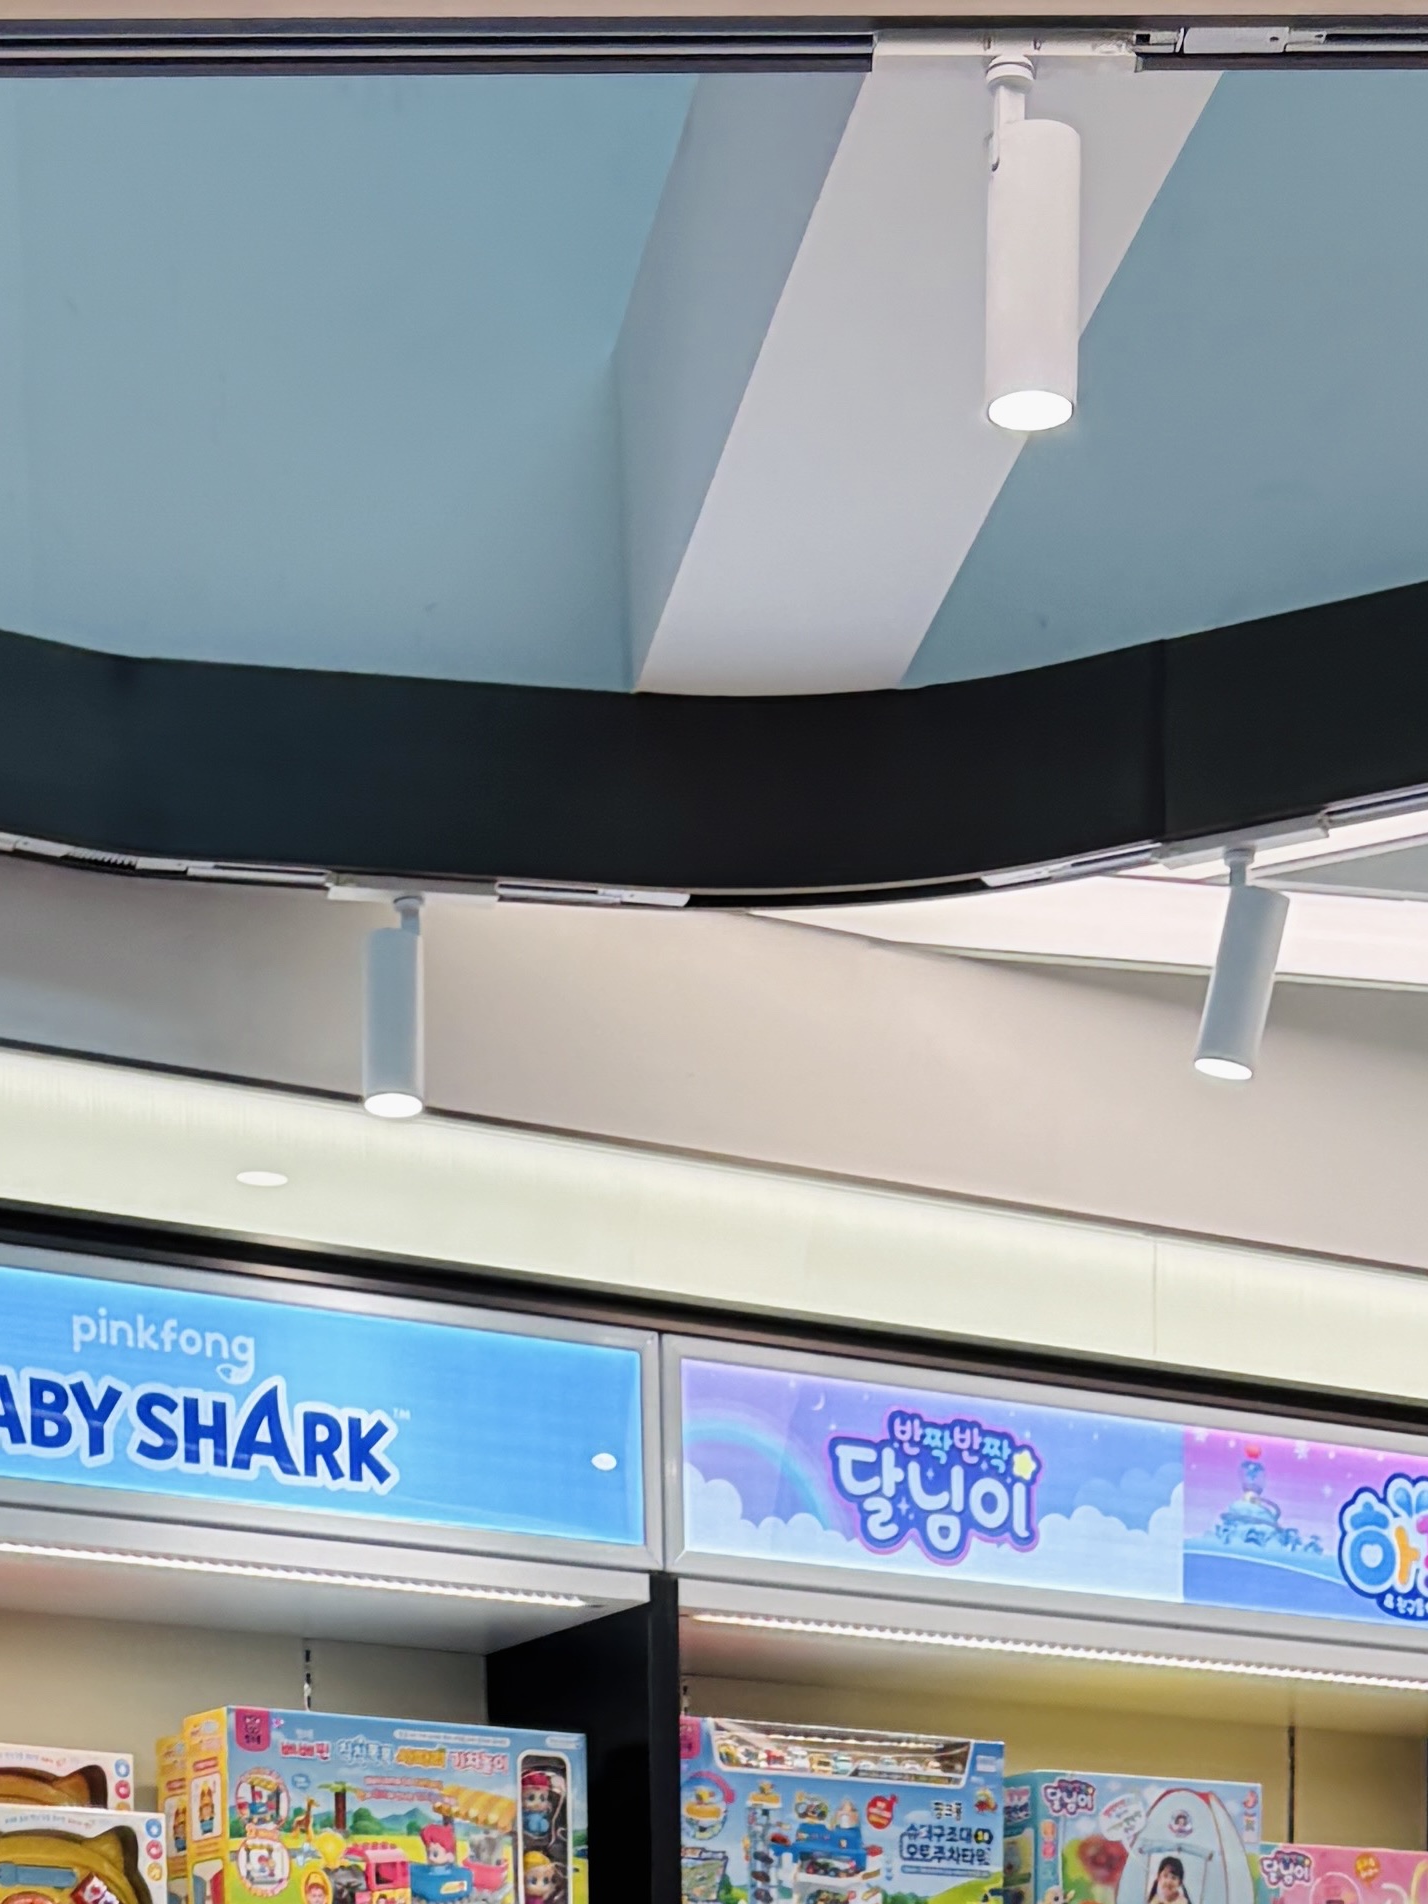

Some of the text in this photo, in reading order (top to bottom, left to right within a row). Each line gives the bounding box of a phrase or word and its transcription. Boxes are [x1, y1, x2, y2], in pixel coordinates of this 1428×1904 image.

[72, 1309, 255, 1382] pinkfong
[137, 1383, 396, 1484] SHARK
[893, 1417, 1012, 1474] 반짝반짝
[835, 1442, 1030, 1552] 달님이
